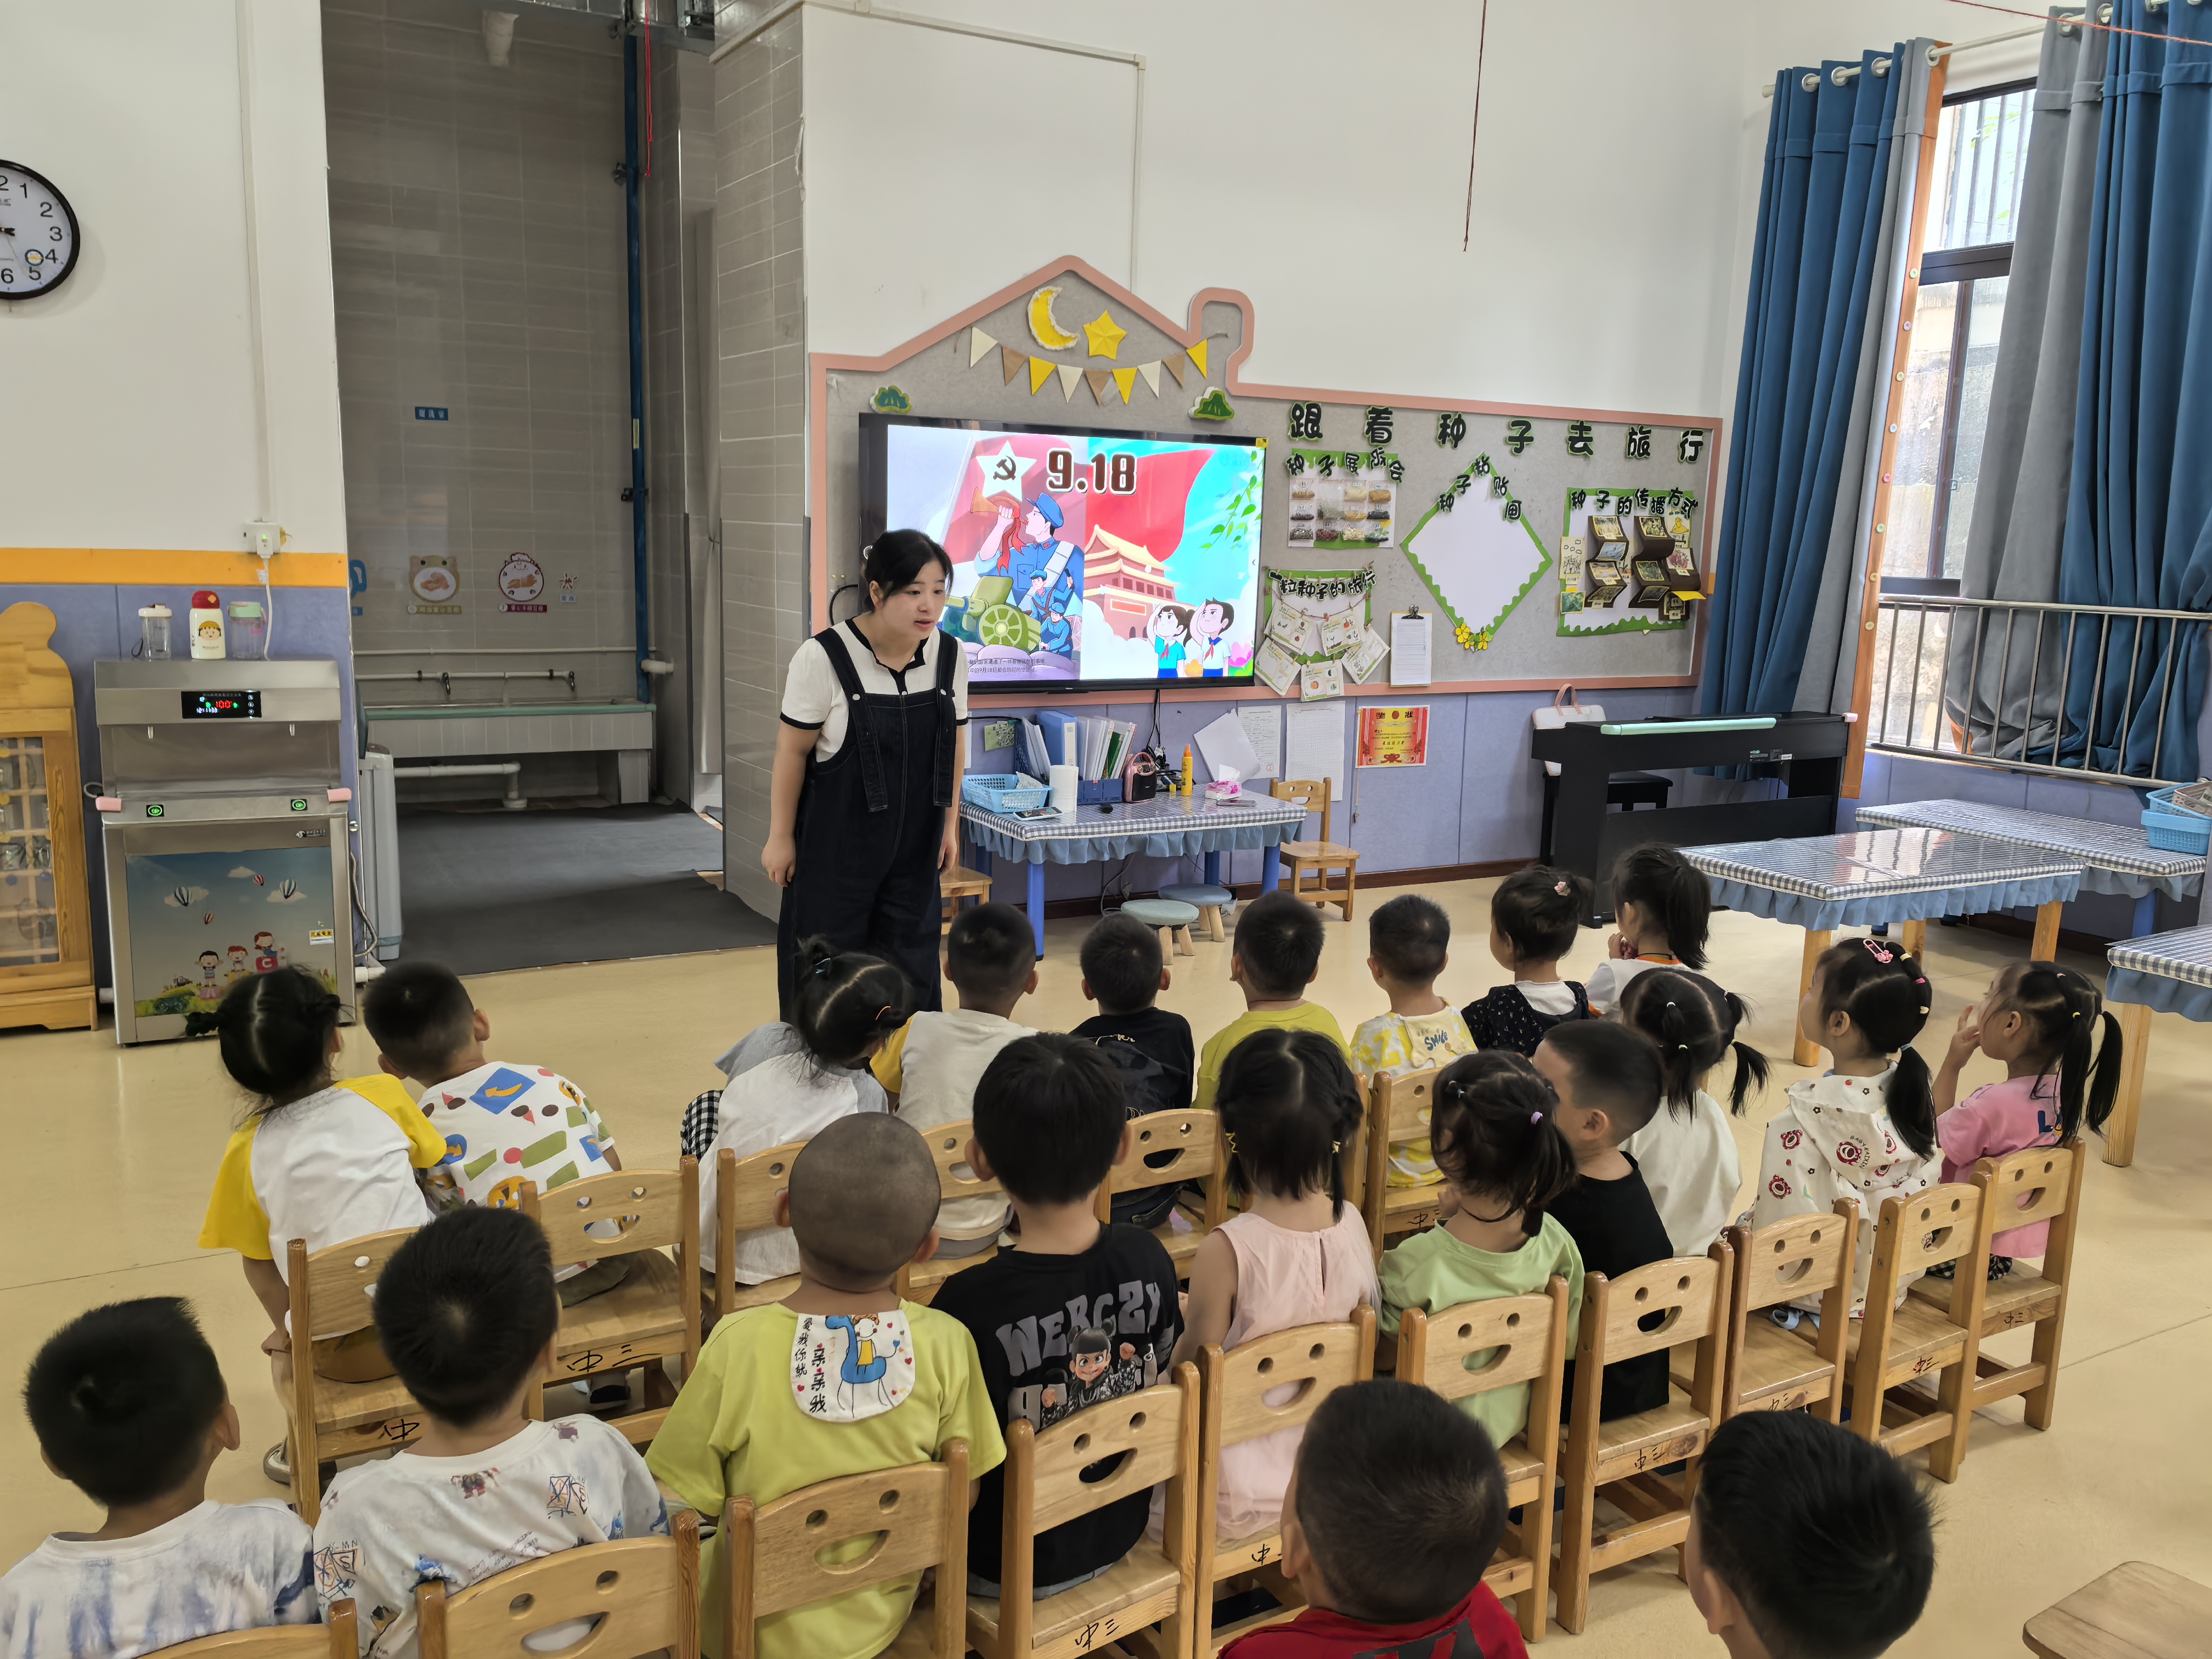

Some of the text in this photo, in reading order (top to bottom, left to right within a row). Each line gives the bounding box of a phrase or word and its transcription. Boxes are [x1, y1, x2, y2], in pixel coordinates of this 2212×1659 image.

[0, 175, 9, 191] 2
[20, 183, 28, 198] 1
[40, 202, 53, 218] 2
[50, 226, 63, 241] 3
[45, 248, 59, 264] 4
[1, 268, 14, 284] 6
[29, 266, 41, 280] 5
[1290, 402, 1704, 462] 跟着种子去旅行
[1047, 449, 1136, 493] 9.18
[1571, 487, 1698, 520] 种子的传播方式
[1269, 570, 1377, 600] 一粒种子的旅行
[567, 1344, 663, 1373] 中三
[1634, 1447, 1666, 1472] 中三
[1251, 1543, 1282, 1566] 中
[1074, 1618, 1121, 1651] 中三
